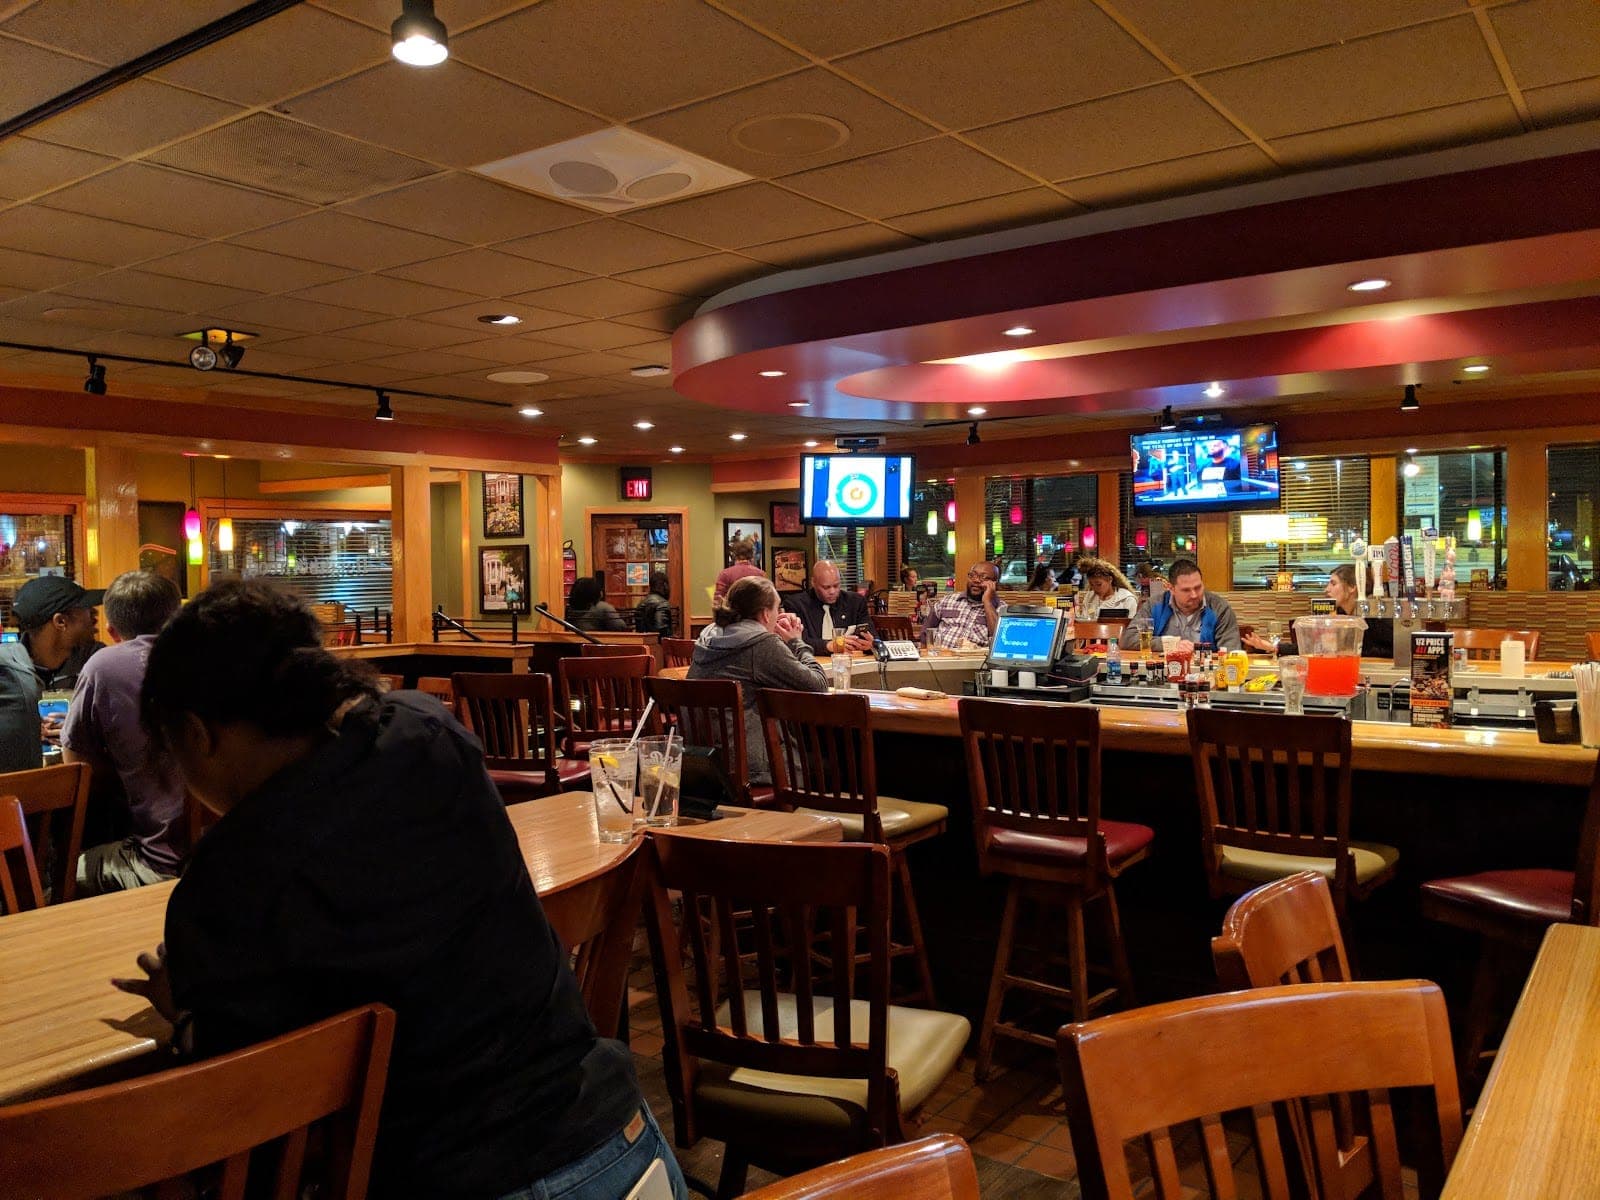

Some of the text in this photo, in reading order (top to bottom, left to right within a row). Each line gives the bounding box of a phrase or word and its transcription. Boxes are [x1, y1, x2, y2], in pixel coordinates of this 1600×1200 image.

[626, 480, 649, 497] EXIT
[1403, 544, 1414, 587] BUD LIGHT
[1426, 637, 1445, 646] PRICE
[1427, 646, 1445, 655] APPS
